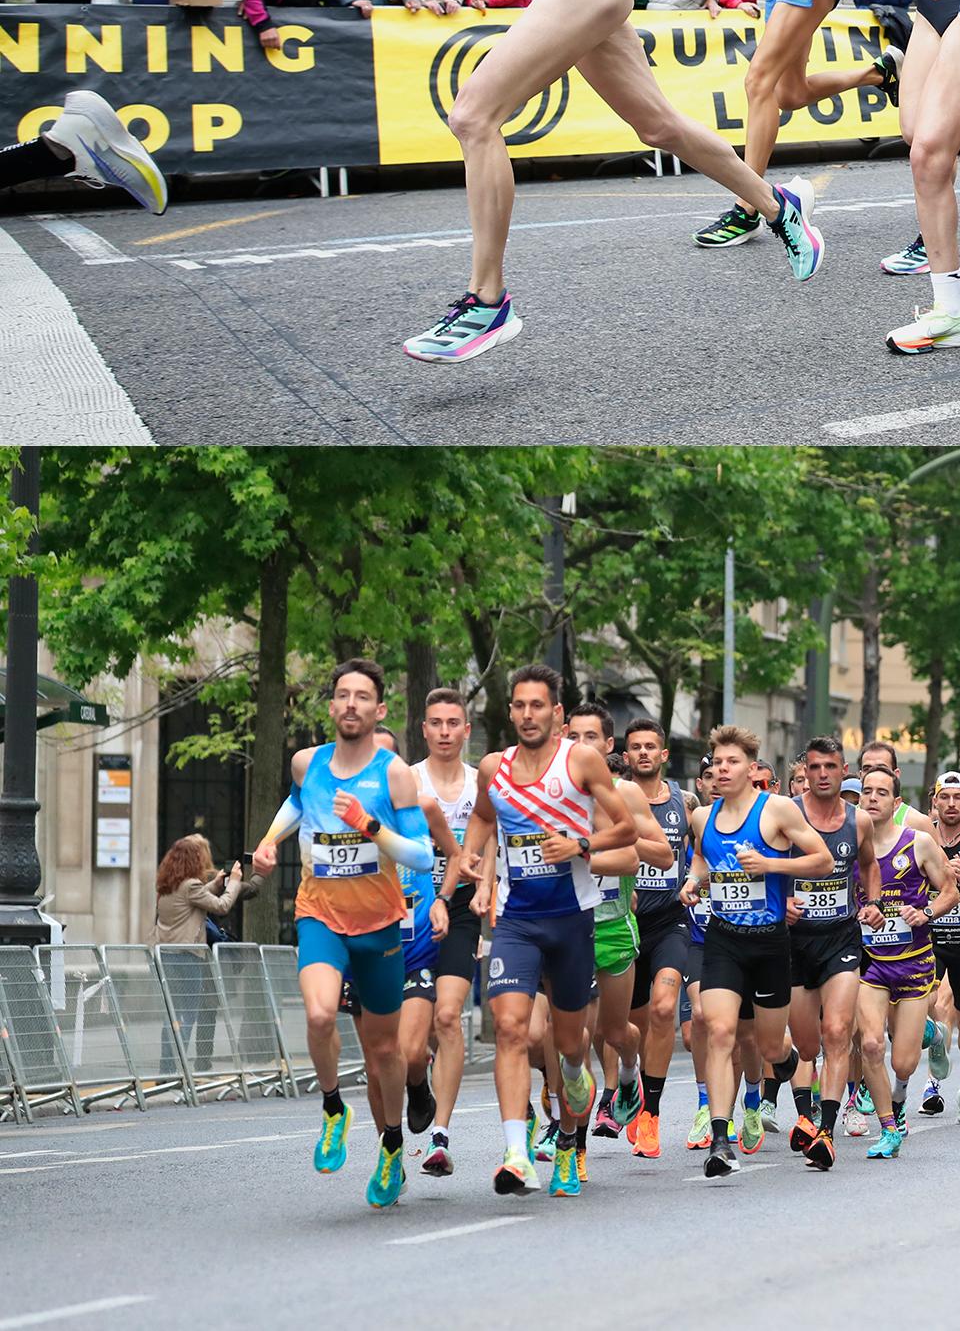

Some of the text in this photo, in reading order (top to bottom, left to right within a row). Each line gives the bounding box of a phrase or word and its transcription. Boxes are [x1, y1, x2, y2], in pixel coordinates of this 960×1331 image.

[638, 26, 882, 67] RUNIN
[328, 847, 360, 864] 197
[521, 848, 543, 865] 15
[326, 864, 363, 876] Joma
[520, 864, 558, 878] Joma
[635, 877, 667, 888] Joma
[721, 884, 750, 900] 139
[720, 901, 753, 911] Joma
[808, 893, 837, 907] 385
[806, 908, 838, 918] Joma
[719, 921, 777, 934] NIKE PRO
[871, 934, 900, 945] Joma
